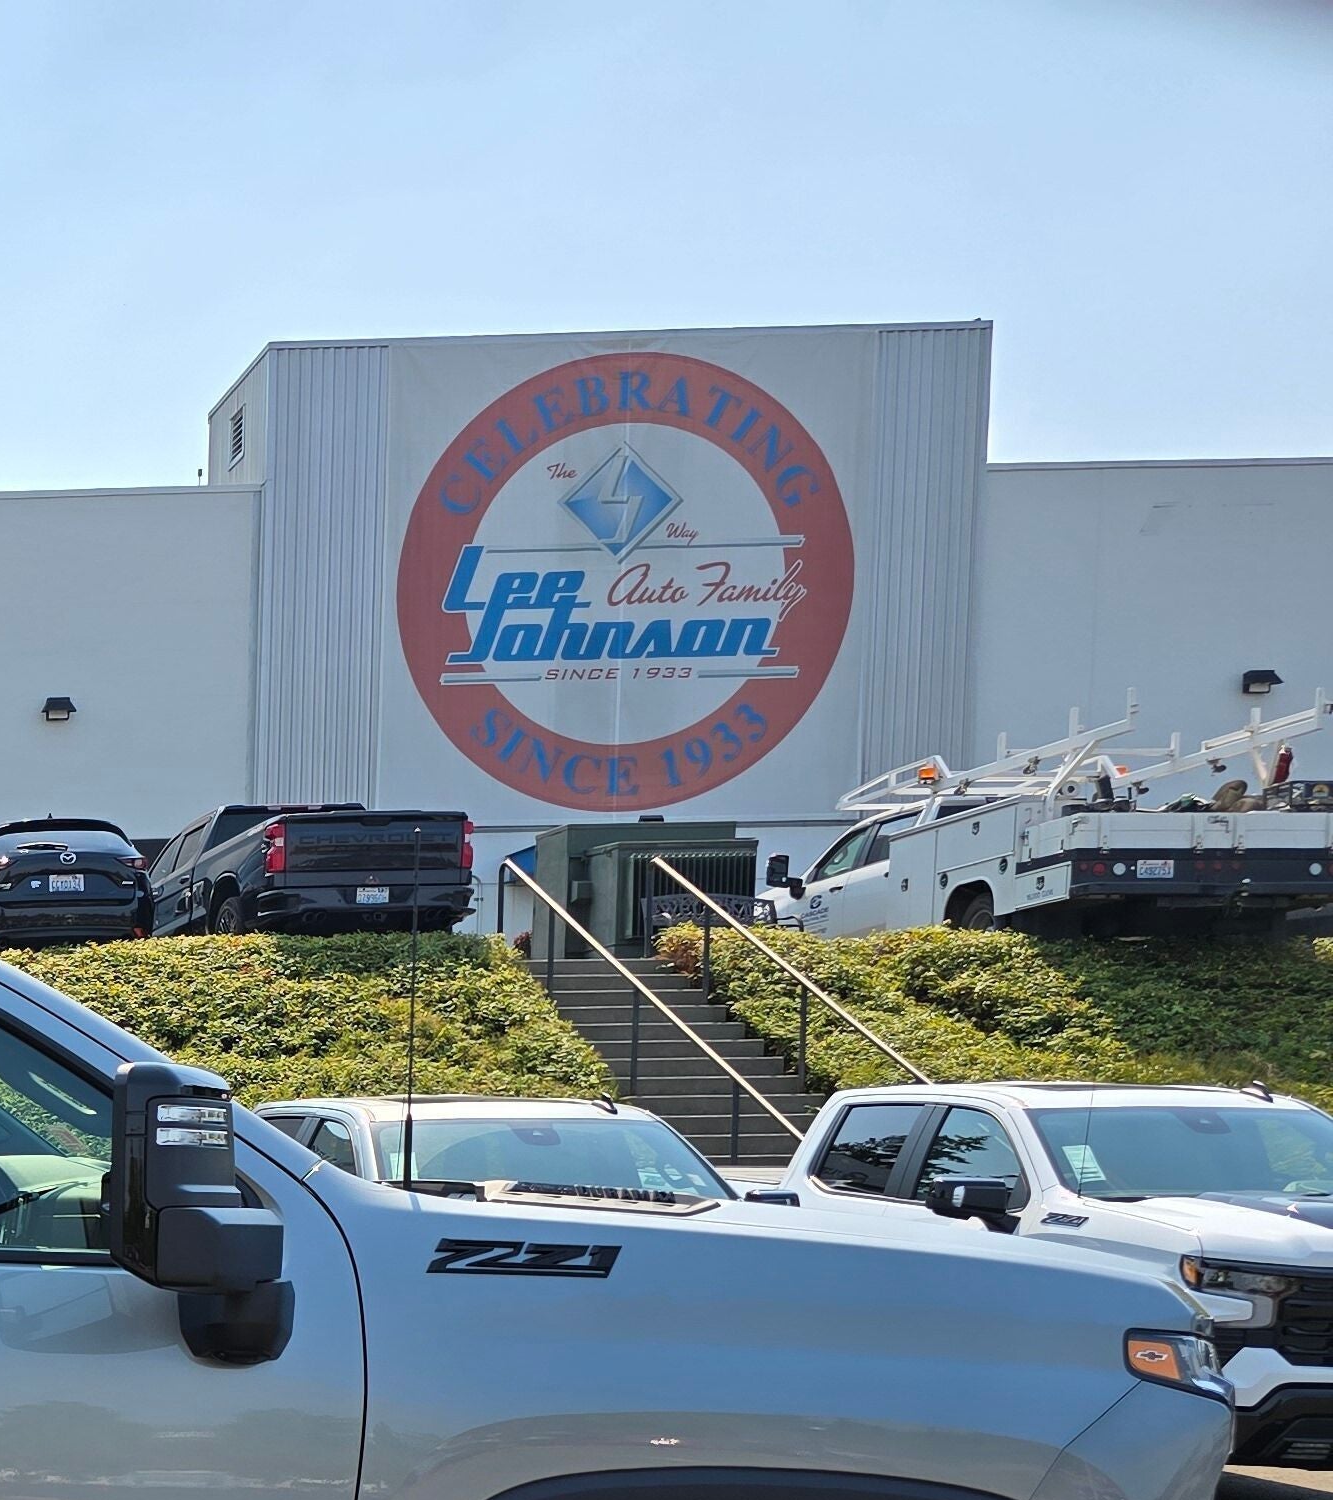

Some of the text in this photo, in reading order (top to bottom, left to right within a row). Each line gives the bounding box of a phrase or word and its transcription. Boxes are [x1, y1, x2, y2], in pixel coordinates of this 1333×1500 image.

[439, 371, 822, 515] CELEBRATING
[547, 463, 578, 480] The
[666, 522, 700, 547] Way
[444, 545, 592, 611] Lee
[606, 559, 807, 622] Auto Family
[446, 600, 780, 664] Johnson
[544, 667, 693, 681] SINCE 1933
[469, 704, 769, 797] SINCE 1933
[298, 831, 455, 845] CHEVROLET
[426, 1237, 623, 1279] Z71
